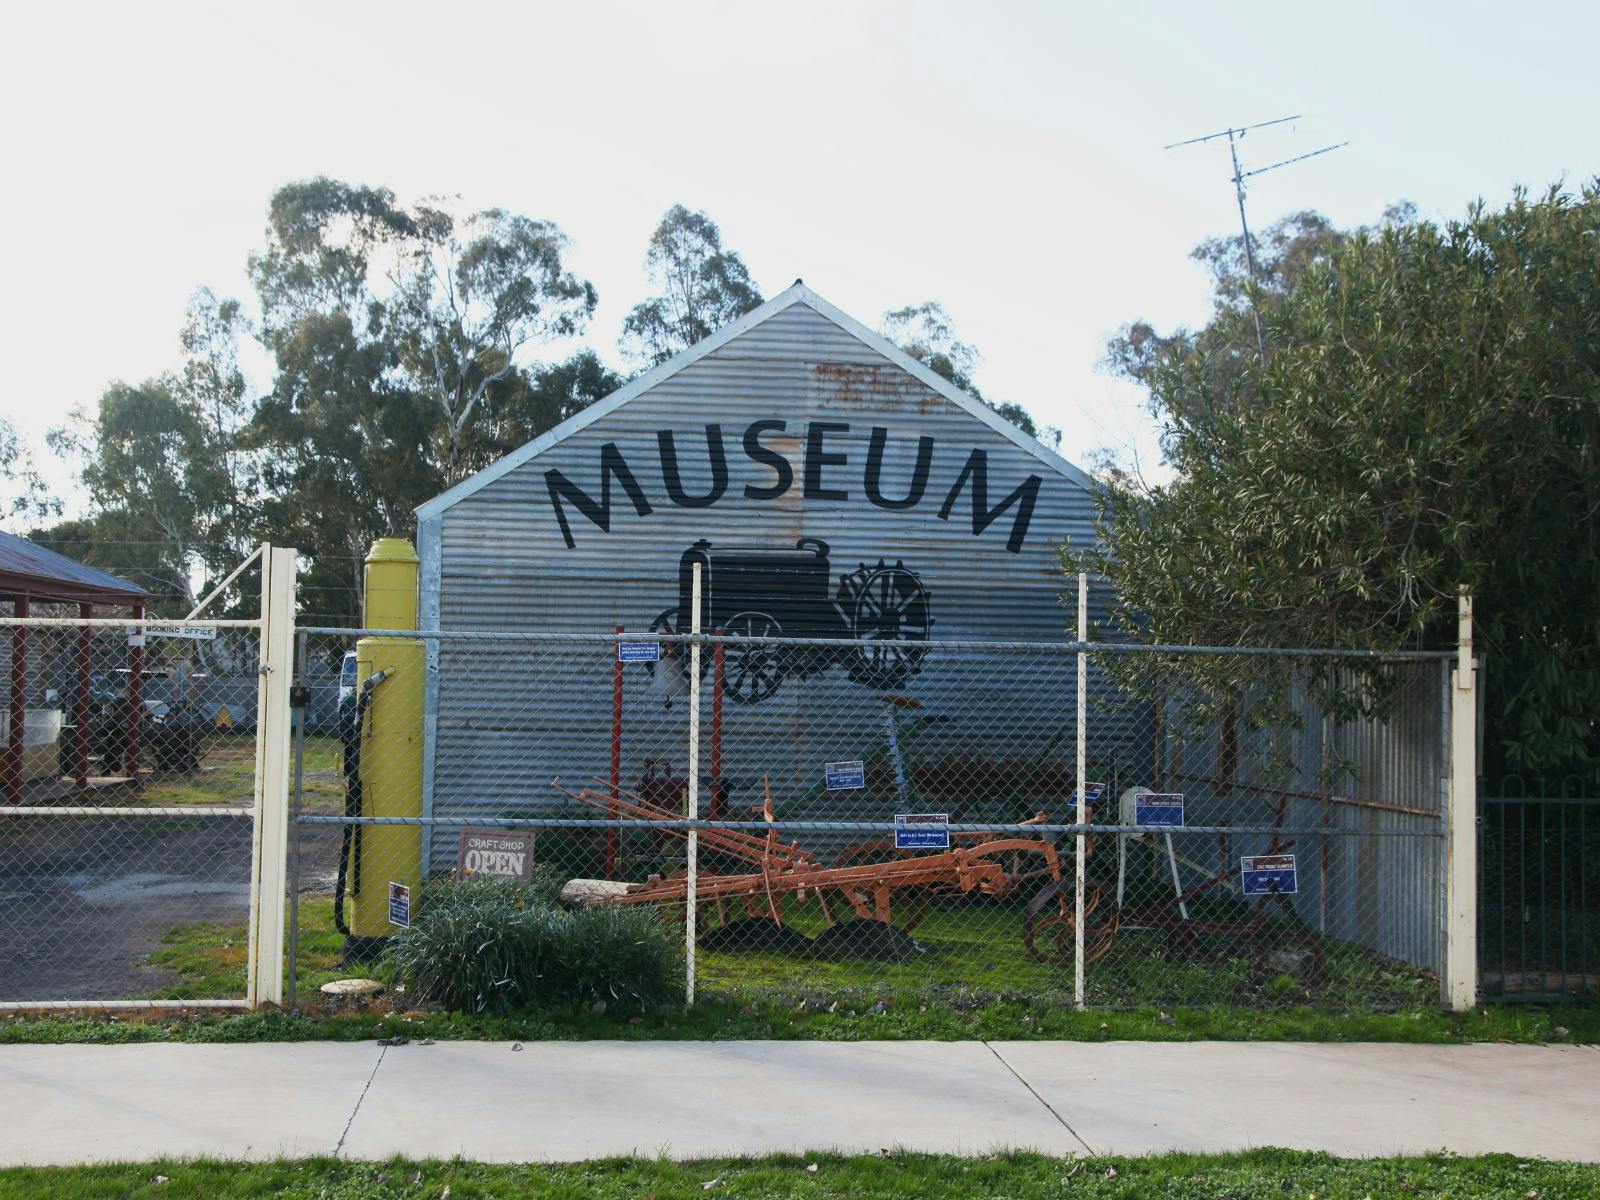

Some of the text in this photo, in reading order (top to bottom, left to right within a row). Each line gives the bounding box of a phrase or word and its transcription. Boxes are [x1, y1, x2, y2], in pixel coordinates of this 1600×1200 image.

[544, 420, 1043, 554] MUSEUM
[146, 625, 214, 637] BOOKING OFFICE
[468, 838, 525, 851] CRAFT SHOP
[465, 849, 526, 876] OPEN
